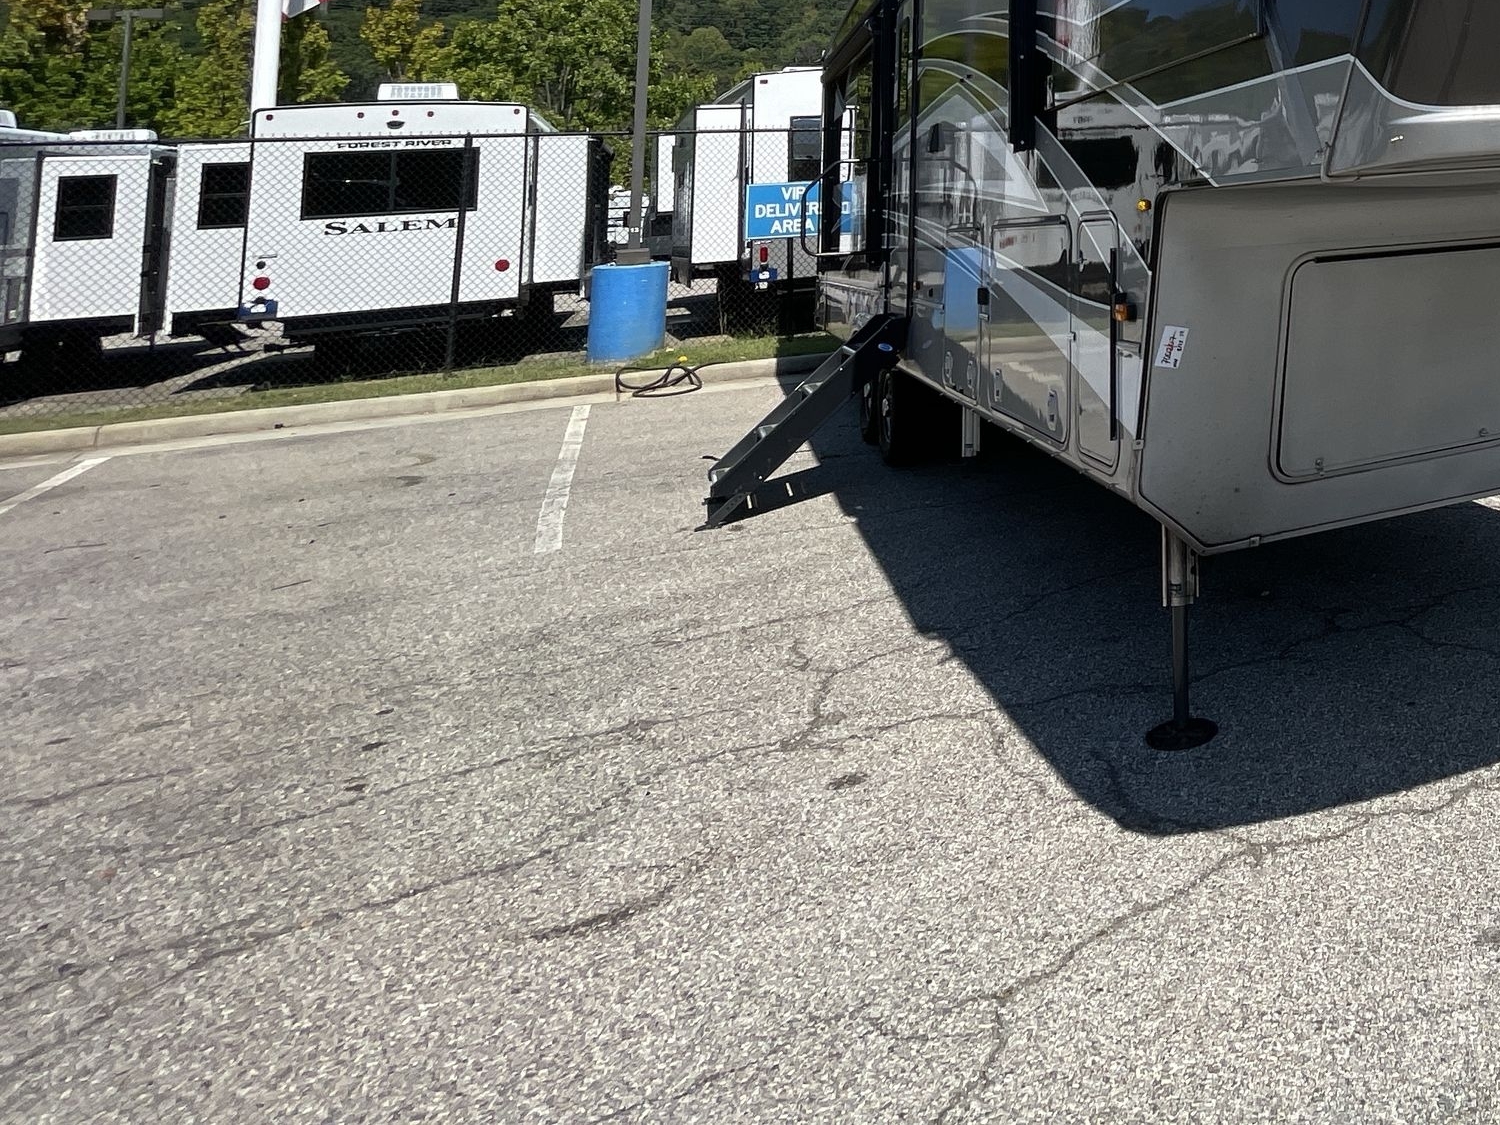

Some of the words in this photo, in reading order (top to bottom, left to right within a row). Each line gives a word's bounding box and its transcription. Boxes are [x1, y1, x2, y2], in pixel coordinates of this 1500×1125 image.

[337, 141, 400, 149] FOREST
[404, 139, 452, 147] RIVER
[781, 186, 806, 201] VIP
[755, 201, 822, 218] DELIVR
[324, 218, 457, 236] SALEM
[770, 218, 815, 234] AREA
